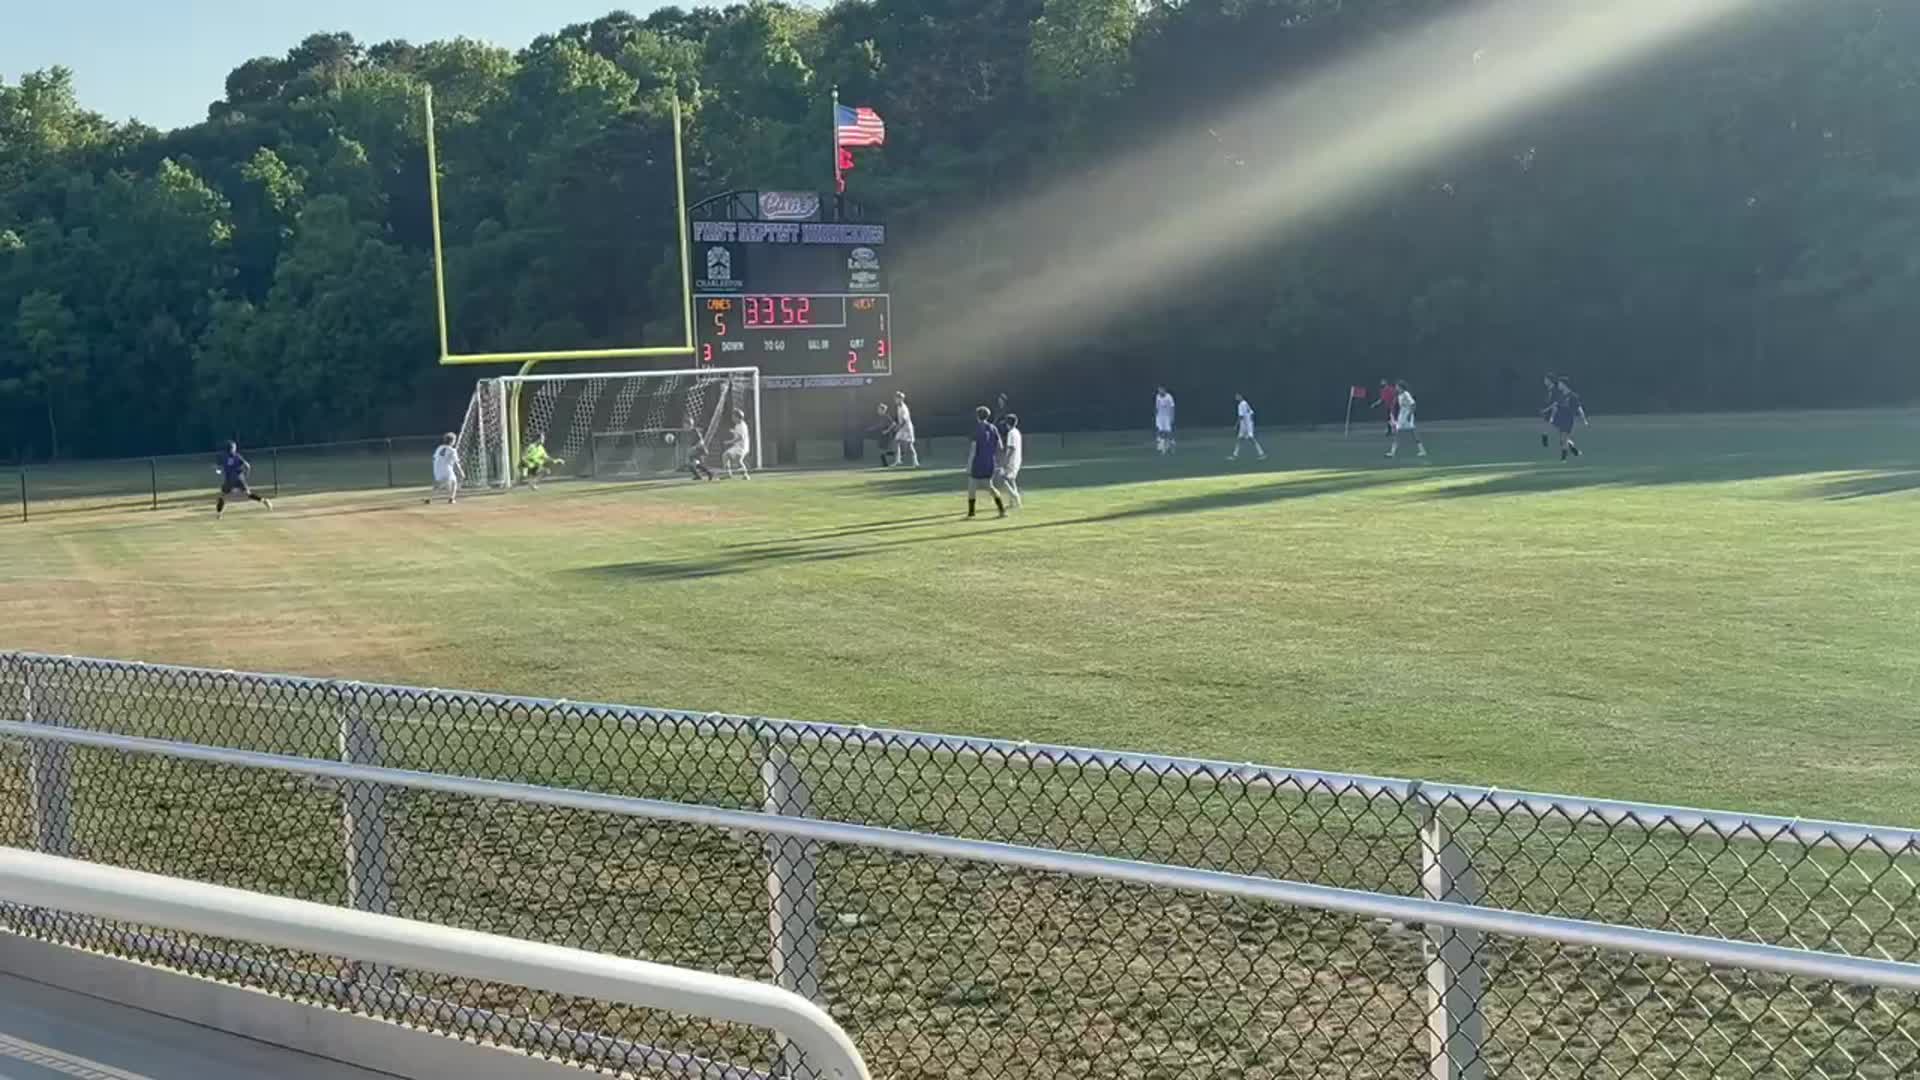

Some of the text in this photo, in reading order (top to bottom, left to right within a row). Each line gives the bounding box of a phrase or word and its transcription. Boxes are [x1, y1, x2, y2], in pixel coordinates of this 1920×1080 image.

[714, 313, 726, 336] 5
[703, 343, 712, 361] 3
[877, 340, 886, 357] 3
[848, 351, 857, 373] 2
